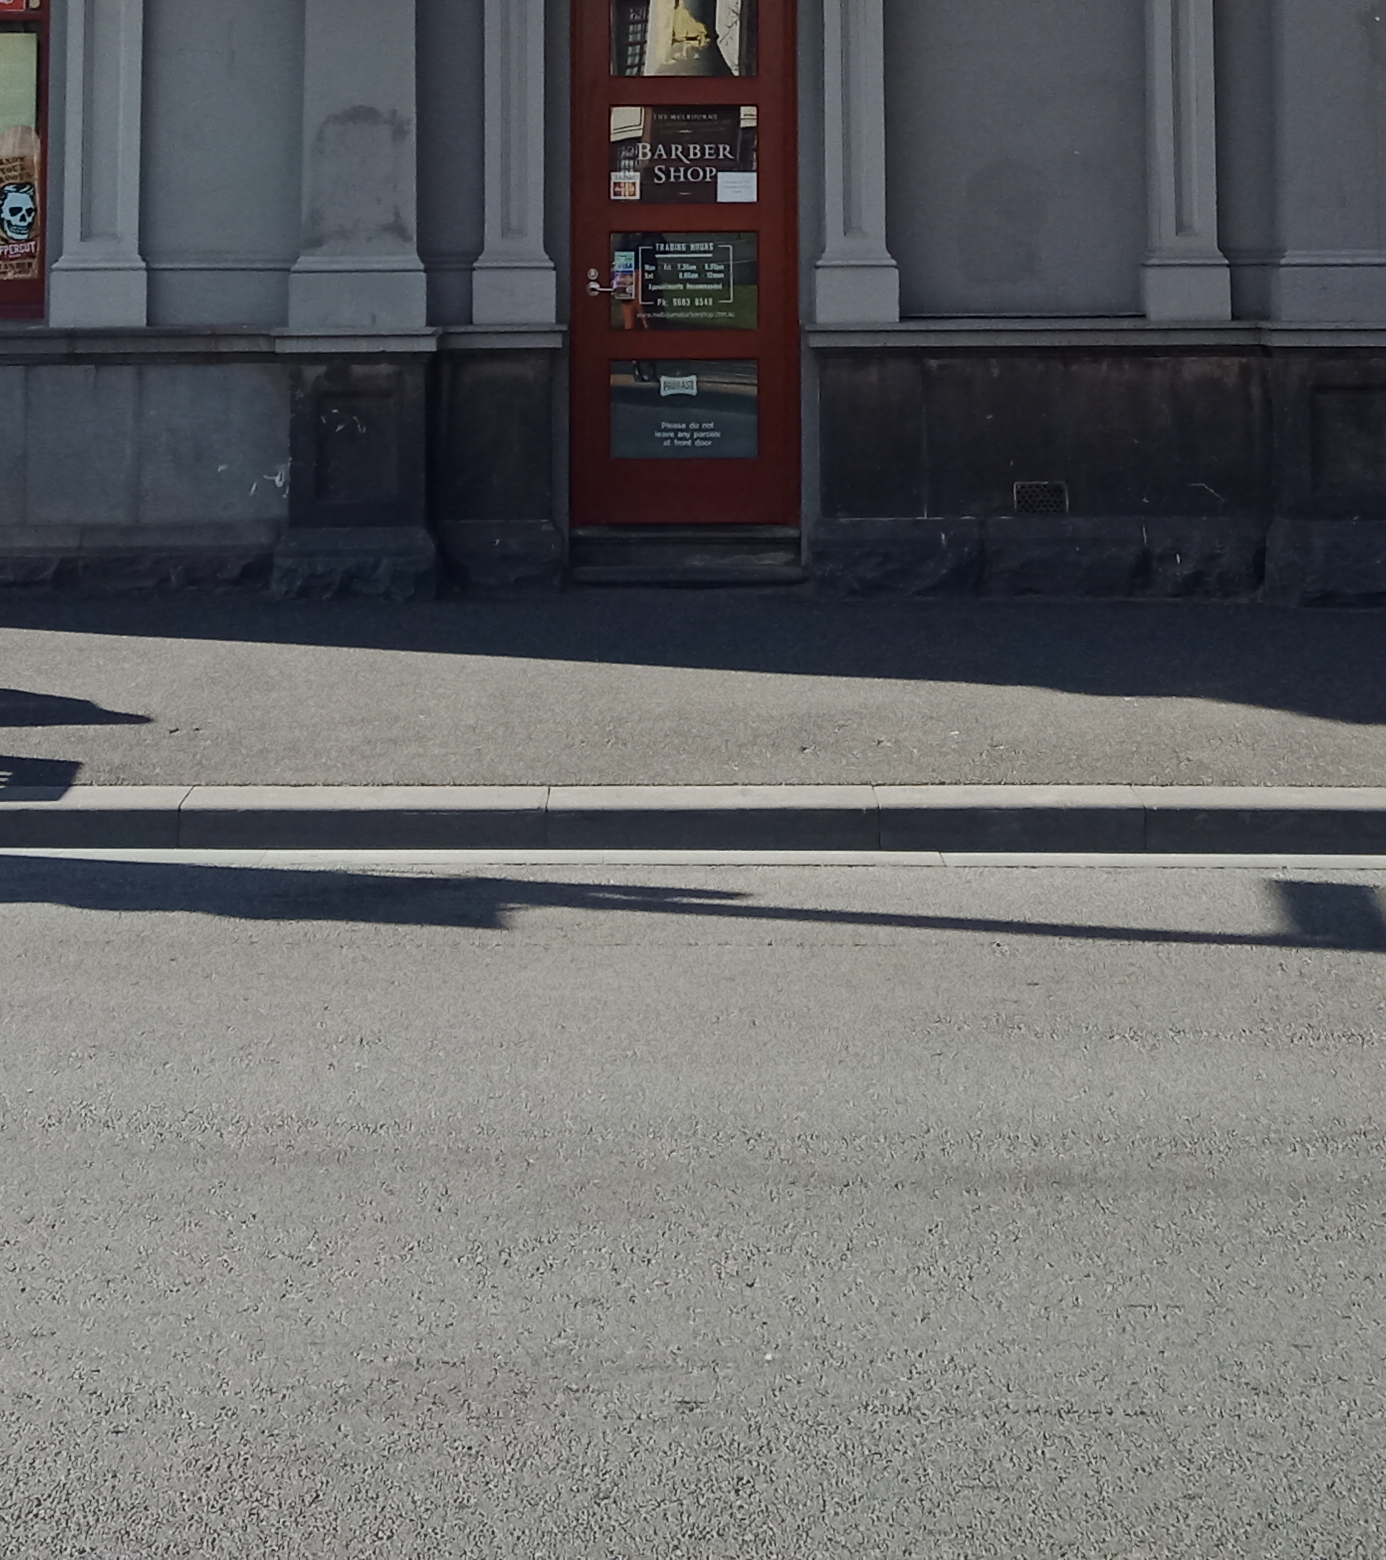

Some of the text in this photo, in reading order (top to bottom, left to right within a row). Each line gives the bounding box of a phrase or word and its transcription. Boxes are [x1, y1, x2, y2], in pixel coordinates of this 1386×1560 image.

[636, 142, 735, 164] BARBER
[653, 165, 716, 184] SHOP
[655, 242, 714, 251] TRADING HOURS
[661, 421, 714, 429] Please do not
[677, 431, 691, 439] any
